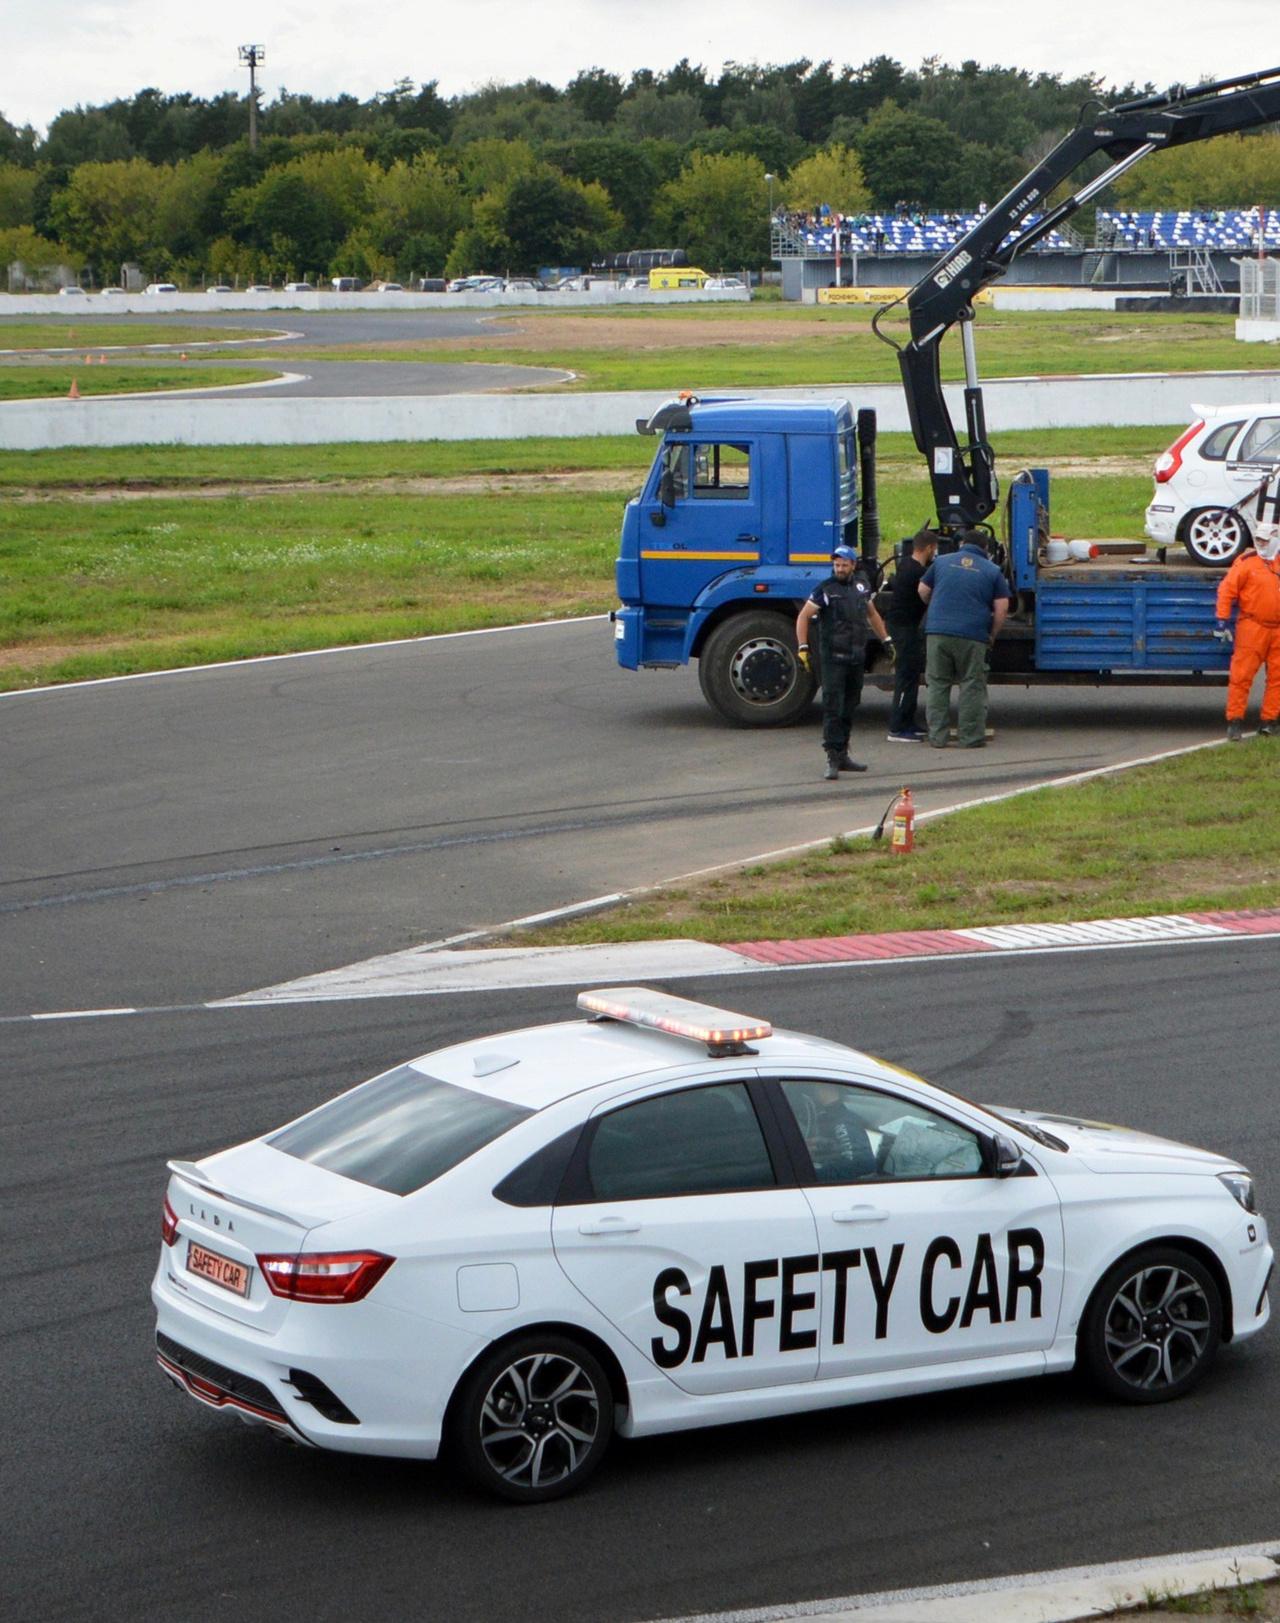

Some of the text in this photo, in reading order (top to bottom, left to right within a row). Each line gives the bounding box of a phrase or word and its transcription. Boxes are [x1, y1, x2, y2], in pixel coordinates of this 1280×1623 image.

[945, 250, 973, 277] HIAB
[190, 1203, 234, 1232] LADA
[193, 1248, 241, 1288] SAFETY CAR
[651, 1227, 1045, 1369] SAFETY CAR
